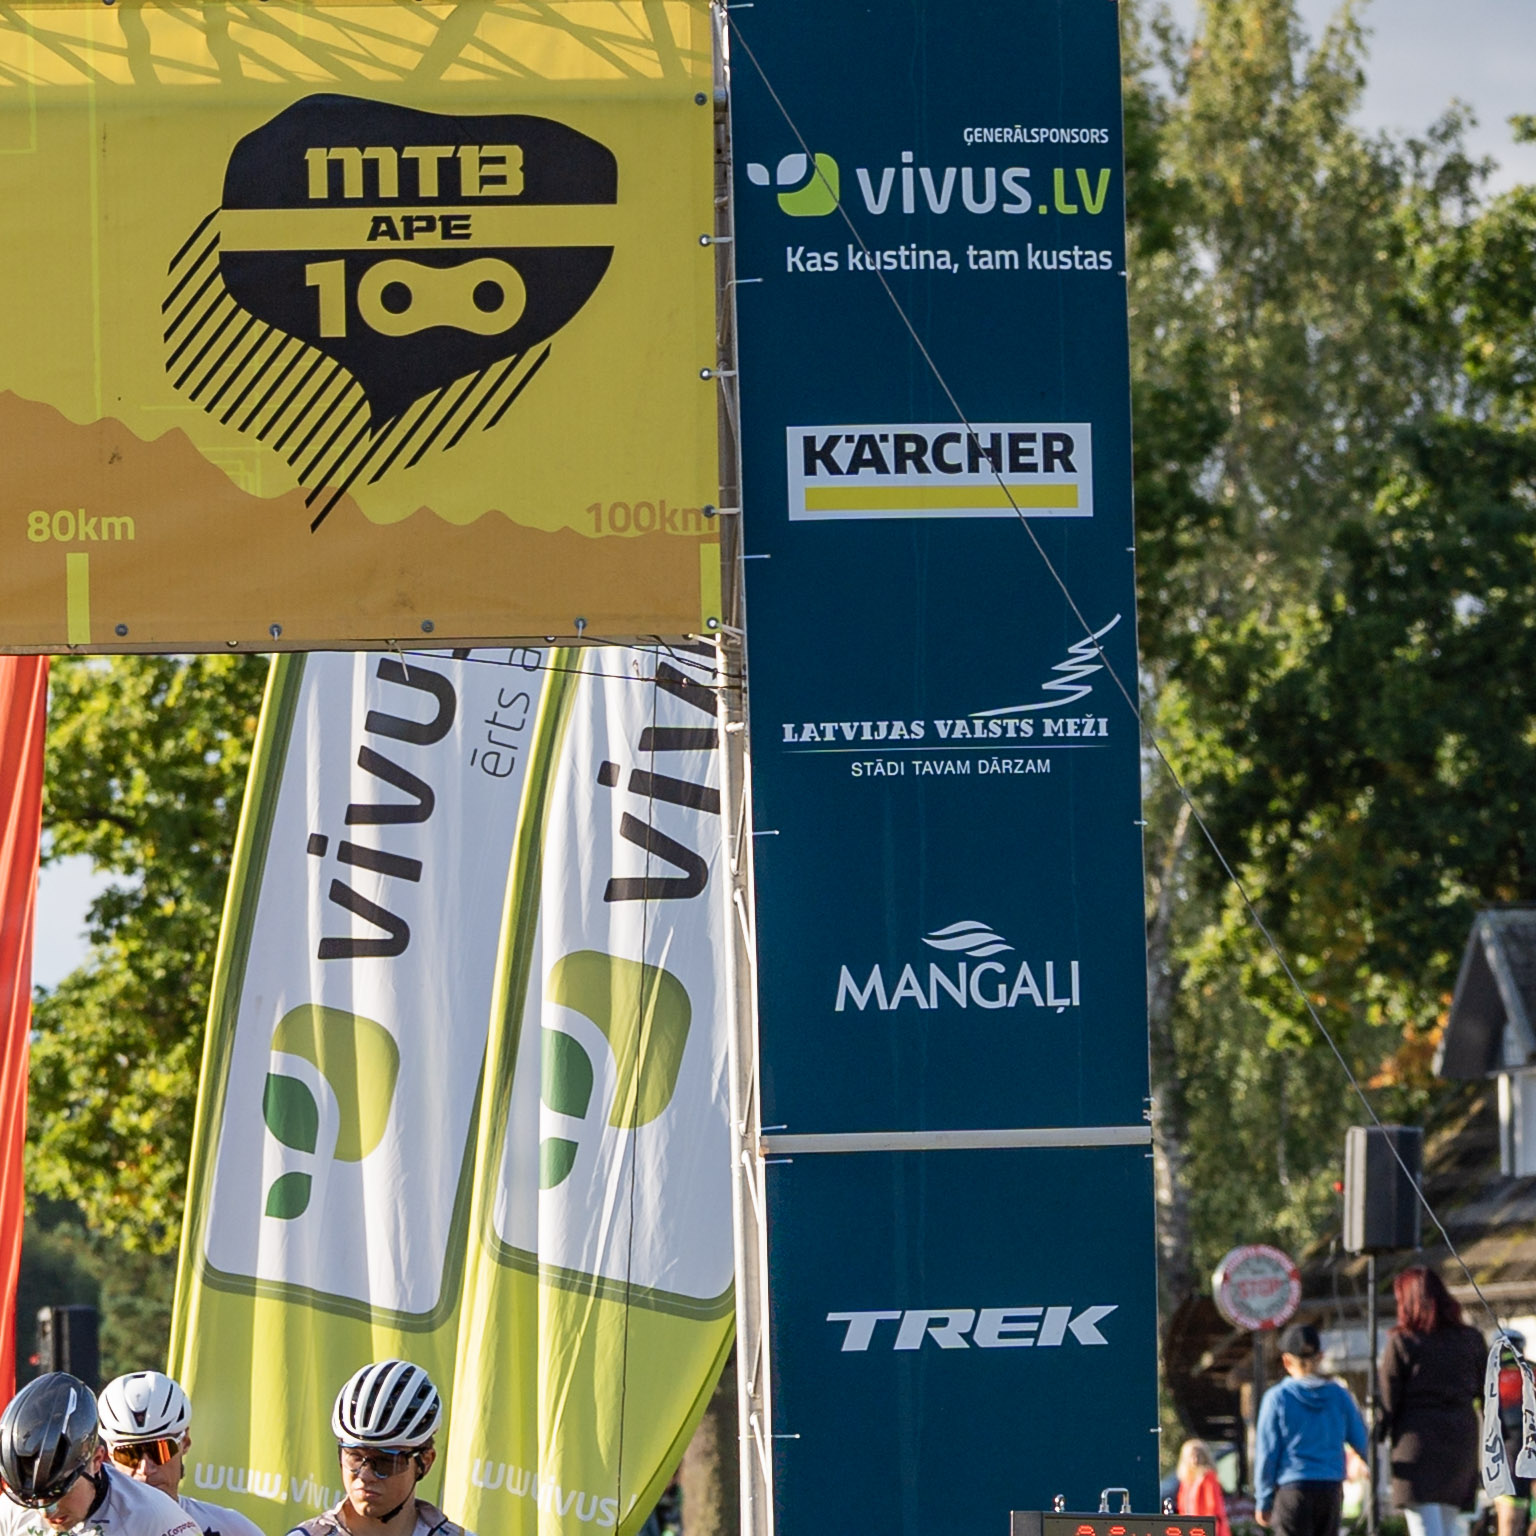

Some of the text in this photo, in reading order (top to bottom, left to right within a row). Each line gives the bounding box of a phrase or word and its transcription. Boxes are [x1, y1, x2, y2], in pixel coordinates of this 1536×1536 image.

[963, 125, 1109, 146] ĢENERĀLSPONSORS
[305, 144, 524, 199] MTB
[367, 214, 473, 242] APE
[786, 243, 1113, 274] Kas kustina, tam kustas
[306, 257, 527, 338] 100
[802, 432, 1078, 477] KÄRCHER
[26, 509, 135, 542] 80km
[586, 501, 717, 536] 100km
[470, 688, 530, 778] ērts
[782, 714, 1110, 743] LATVIJAS VALSTS MEŽI
[851, 756, 1051, 777] STĀDI TAVAM DĀRZAM
[307, 650, 469, 960] vivu
[835, 961, 1080, 1014] MANGAĻI
[826, 1305, 1119, 1352] TREK
